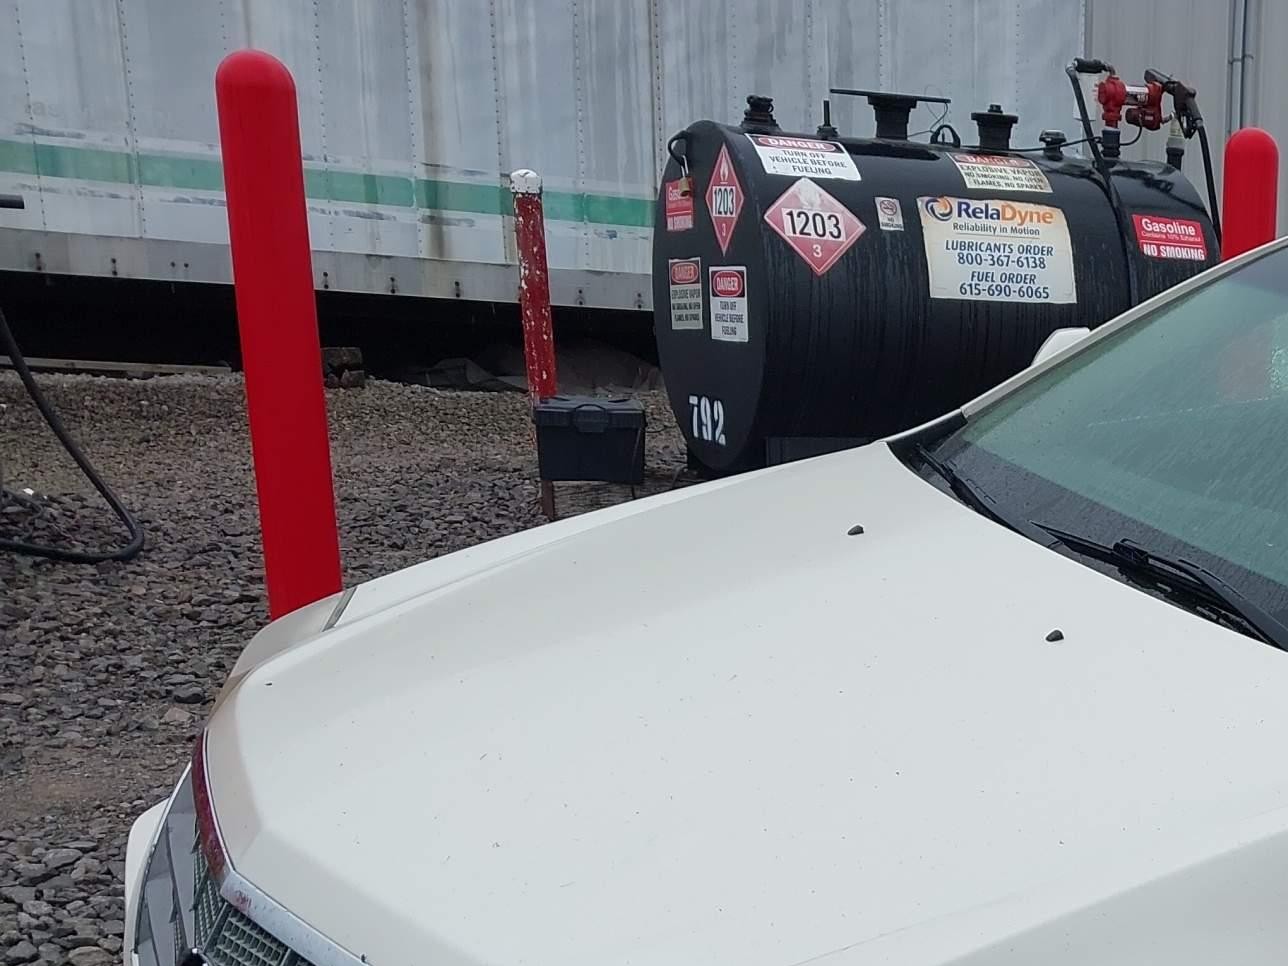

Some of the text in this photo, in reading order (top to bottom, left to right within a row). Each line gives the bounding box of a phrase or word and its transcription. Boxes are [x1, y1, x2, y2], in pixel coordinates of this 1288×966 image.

[768, 138, 826, 150] DANGER
[782, 150, 808, 158] TURN
[769, 156, 847, 168] VEHICLE BEFORE
[792, 165, 832, 175] FUELING
[960, 164, 1042, 177] EXPLOSIVE VAPOR
[714, 188, 734, 215] 1203
[957, 201, 1053, 226] RelaDyne
[722, 223, 726, 236] 3
[786, 210, 842, 239] 1203
[953, 223, 1040, 236] Reliability in Motion
[1142, 218, 1196, 236] Gasoline
[812, 244, 822, 258] 3
[945, 240, 1054, 256] LUBRICANTS ORDER
[1143, 244, 1205, 260] NO SMOKING
[957, 253, 1046, 269] 800-367-6138
[716, 277, 738, 291] DANGER
[971, 271, 1036, 285] FUEL ORDER
[959, 282, 1050, 299] 615-690-6065
[689, 395, 726, 446] 792
